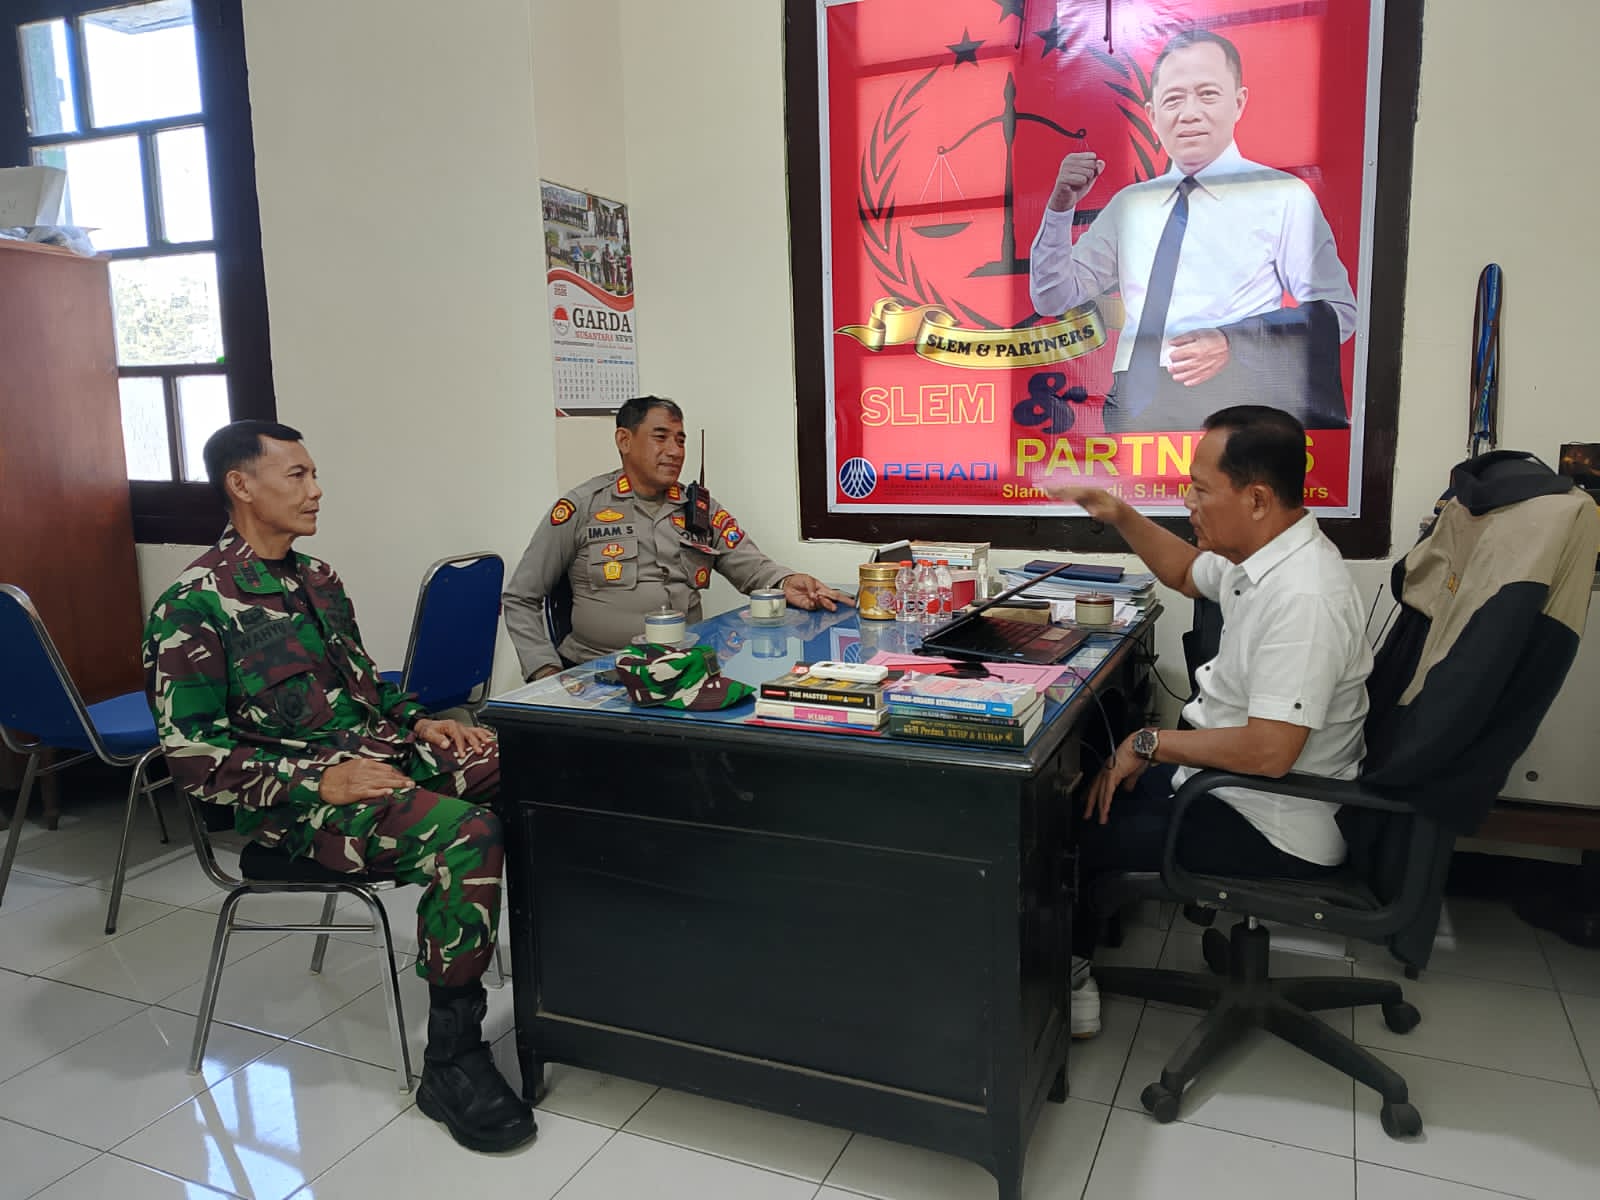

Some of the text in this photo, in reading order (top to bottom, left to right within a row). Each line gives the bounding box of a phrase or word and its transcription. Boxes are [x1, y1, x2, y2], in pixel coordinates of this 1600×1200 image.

[573, 308, 632, 333] GARDA
[576, 331, 633, 343] NUSANTARA NEWS
[926, 324, 1095, 358] SLEM & PARTNERS
[860, 372, 1088, 435] SLEM &
[883, 462, 999, 481] PERADI
[588, 526, 634, 539] IMAM S
[802, 692, 828, 701] MASTER
